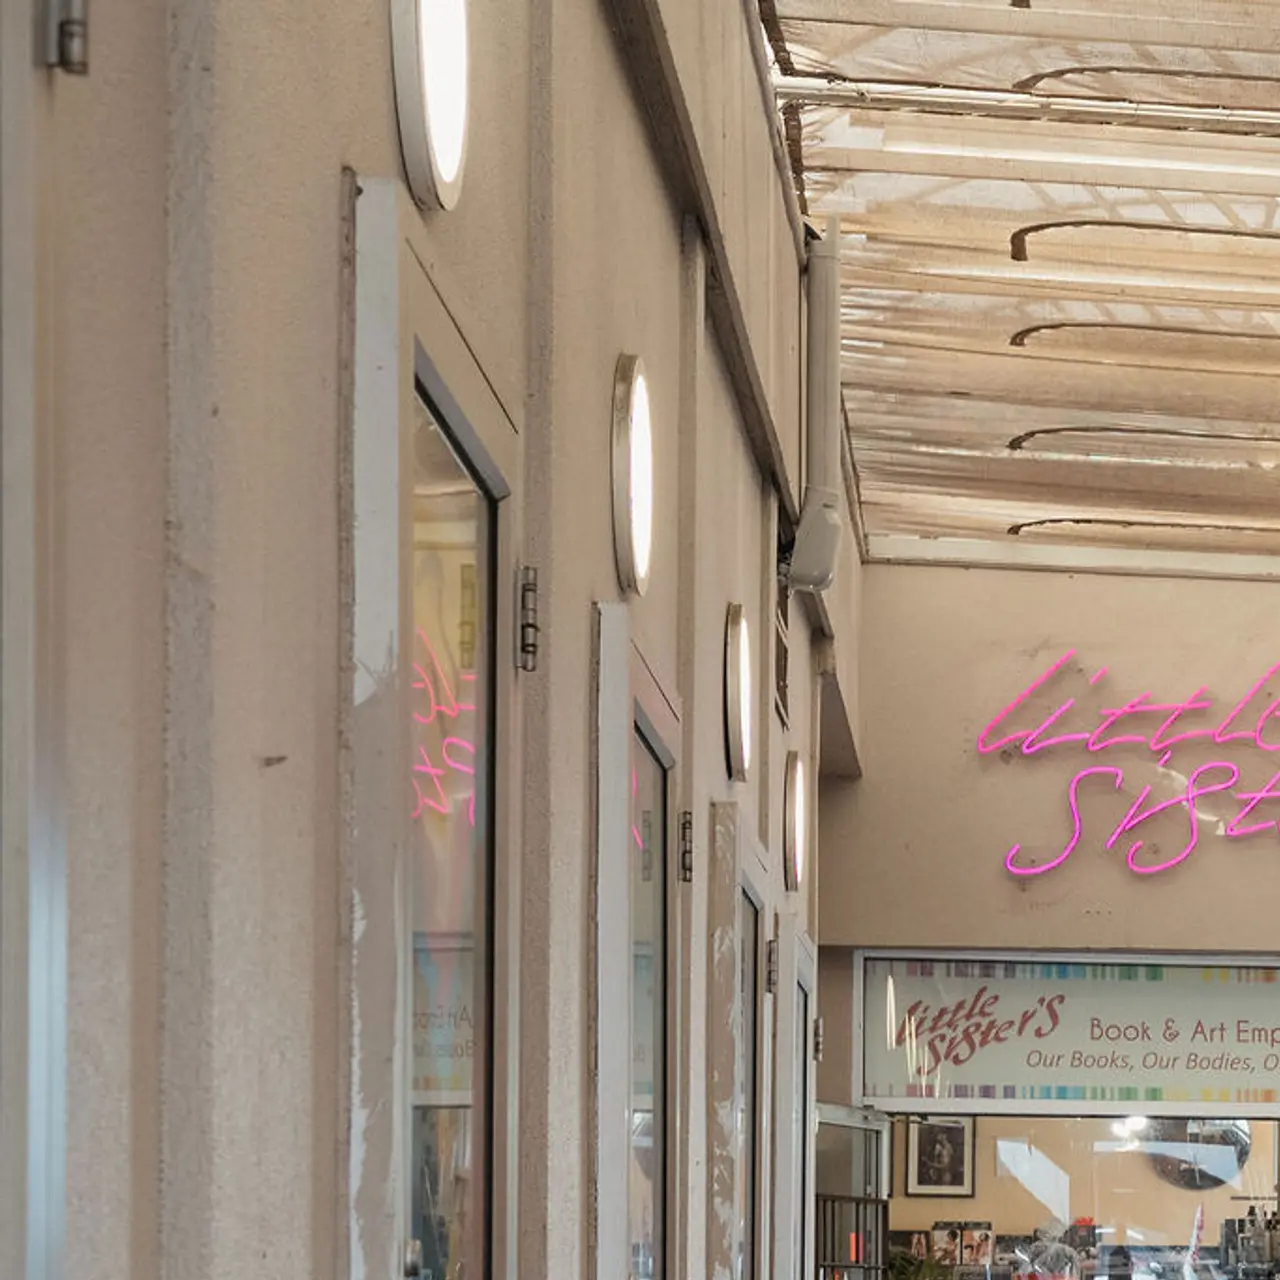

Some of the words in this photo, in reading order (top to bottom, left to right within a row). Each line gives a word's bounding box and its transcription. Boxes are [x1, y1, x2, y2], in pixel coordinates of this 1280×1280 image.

[1090, 1017, 1152, 1042] Book
[1162, 1017, 1180, 1042] &
[1191, 1019, 1226, 1043] Art
[1026, 1049, 1064, 1068] Our
[1070, 1050, 1134, 1072] Books,
[1142, 1052, 1180, 1069] Our
[1185, 1052, 1256, 1074] Bodies,
